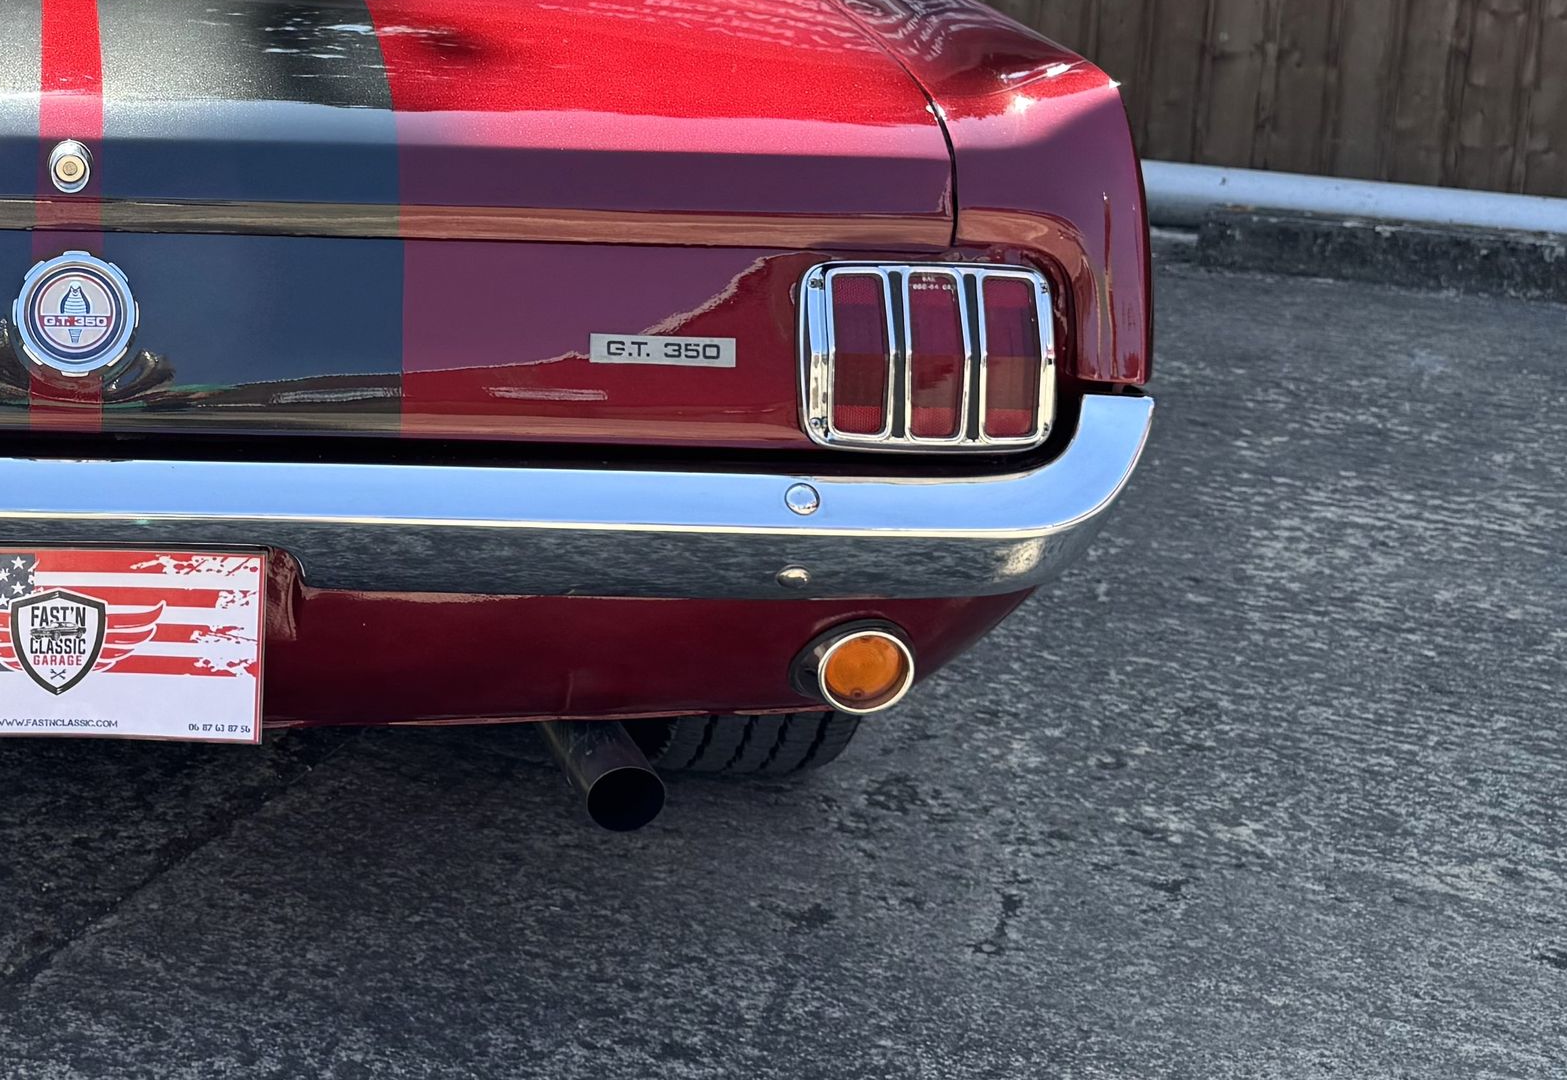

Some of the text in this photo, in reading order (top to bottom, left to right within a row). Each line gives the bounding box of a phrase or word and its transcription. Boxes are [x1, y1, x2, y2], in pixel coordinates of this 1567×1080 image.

[43, 316, 108, 327] G.T. 350
[606, 340, 721, 360] G.T. 350
[31, 605, 86, 627] FAST'N
[30, 637, 86, 655] CLASSIC
[33, 655, 82, 666] GARAGE
[188, 723, 199, 731] 06
[202, 723, 212, 731] 87
[215, 723, 225, 732] 63
[228, 724, 238, 732] 87
